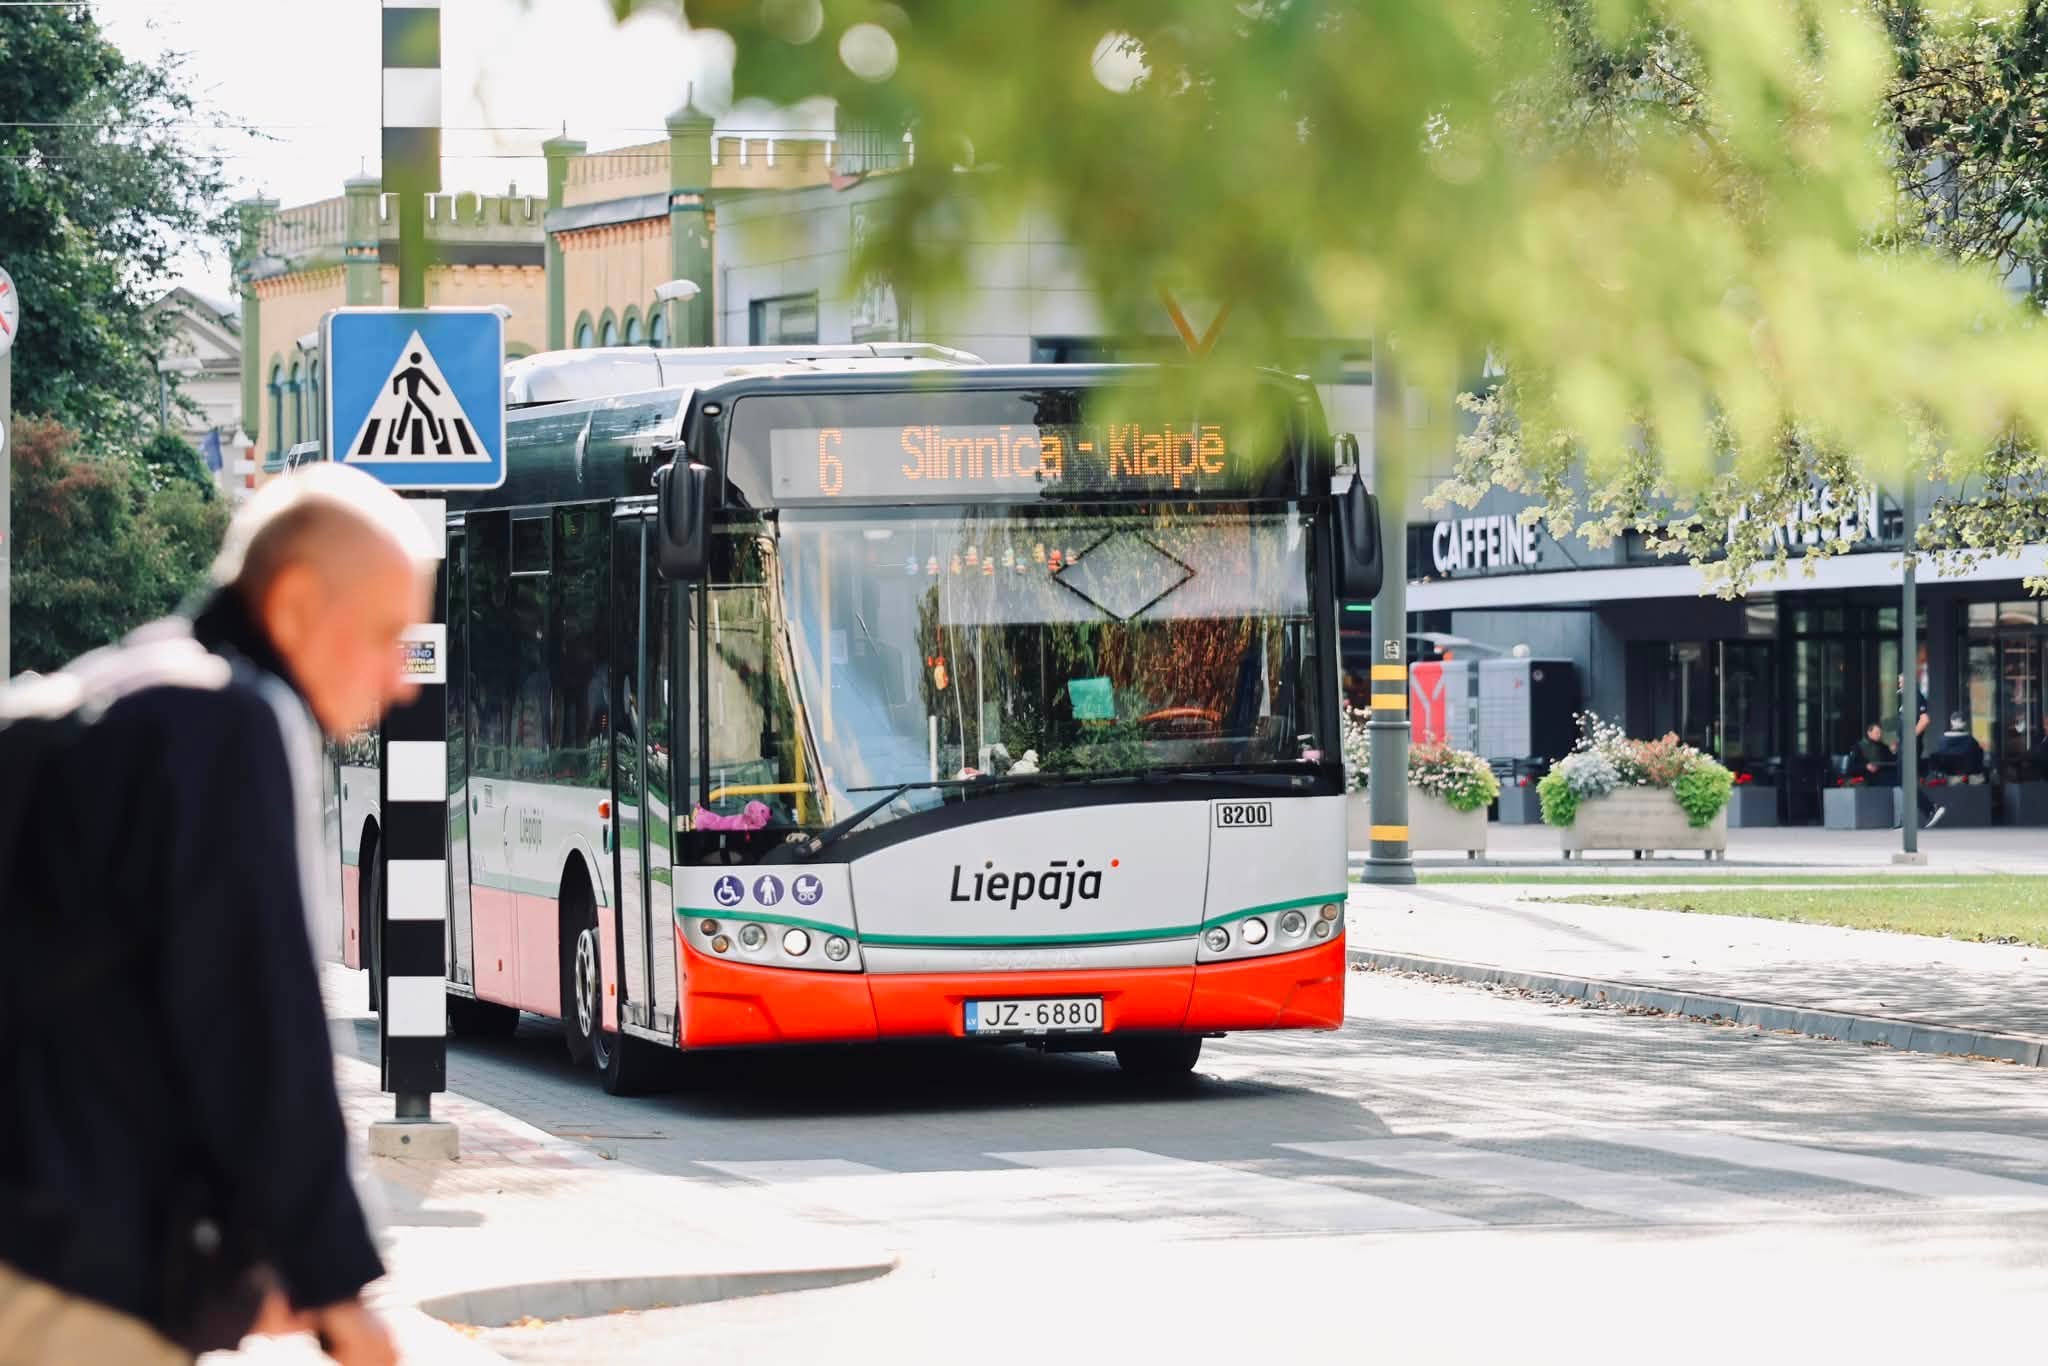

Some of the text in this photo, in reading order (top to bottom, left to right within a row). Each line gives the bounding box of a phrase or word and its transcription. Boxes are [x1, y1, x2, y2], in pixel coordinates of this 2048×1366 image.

[818, 427, 844, 496] 6
[1432, 514, 1537, 573] CAFFEINE
[1222, 805, 1268, 824] 8200
[949, 859, 1103, 910] Liepāja
[985, 1003, 1097, 1026] JZ-6880
